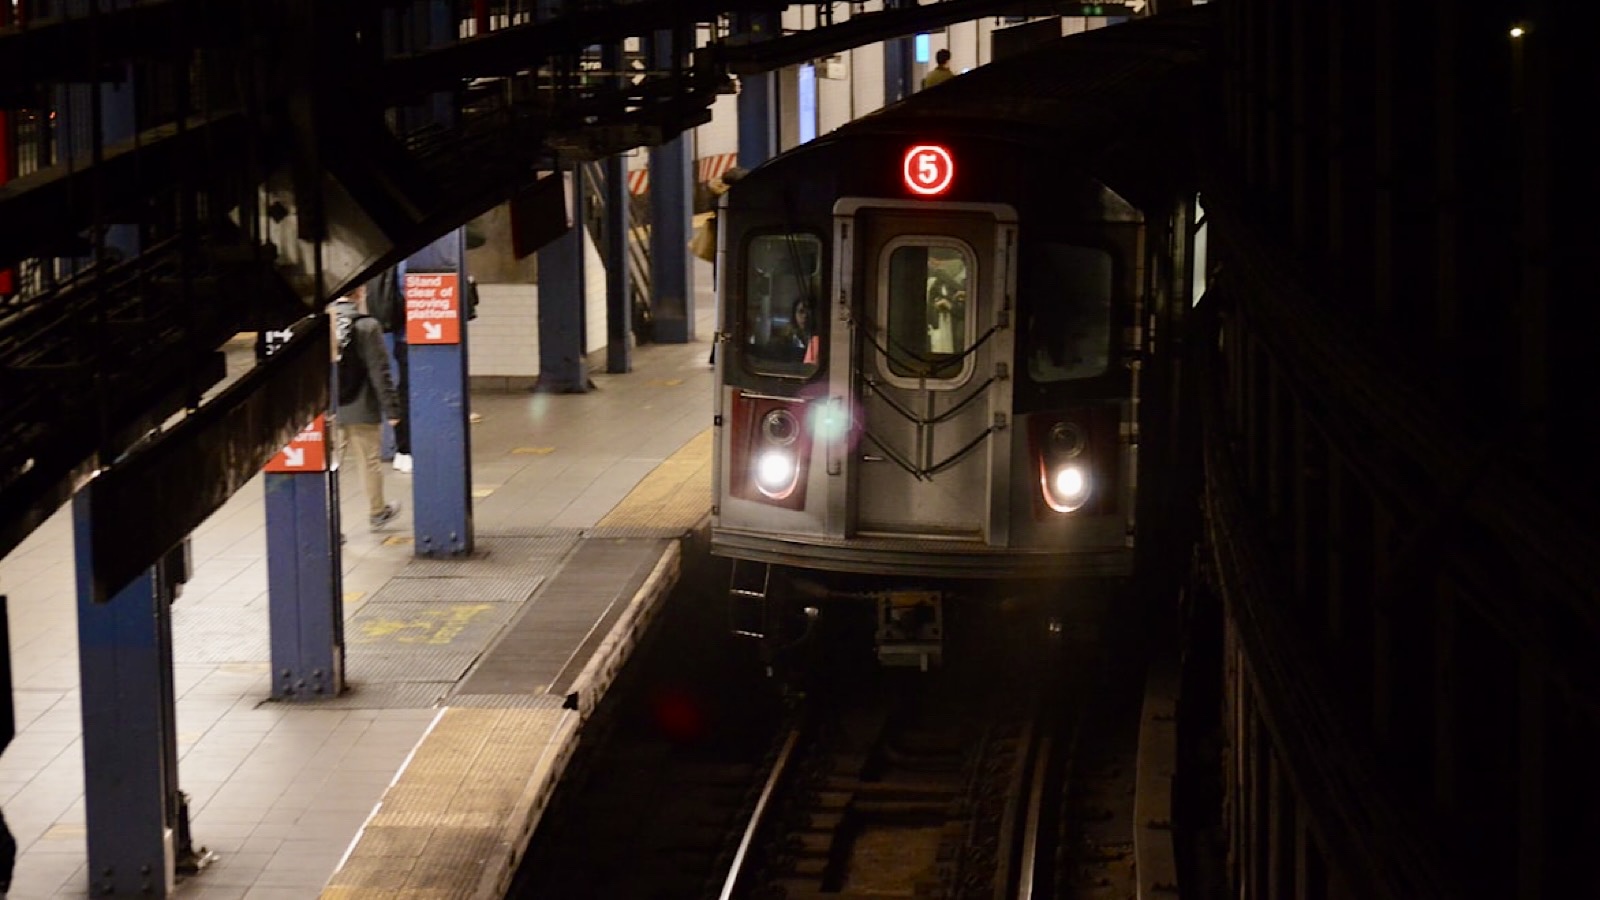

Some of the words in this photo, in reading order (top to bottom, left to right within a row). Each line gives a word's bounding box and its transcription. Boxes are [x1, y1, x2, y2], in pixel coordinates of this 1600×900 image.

[918, 154, 938, 184] 5
[406, 275, 442, 288] Stand
[406, 287, 436, 298] clear
[440, 286, 454, 298] of
[406, 299, 450, 311] moving
[406, 309, 457, 321] platform
